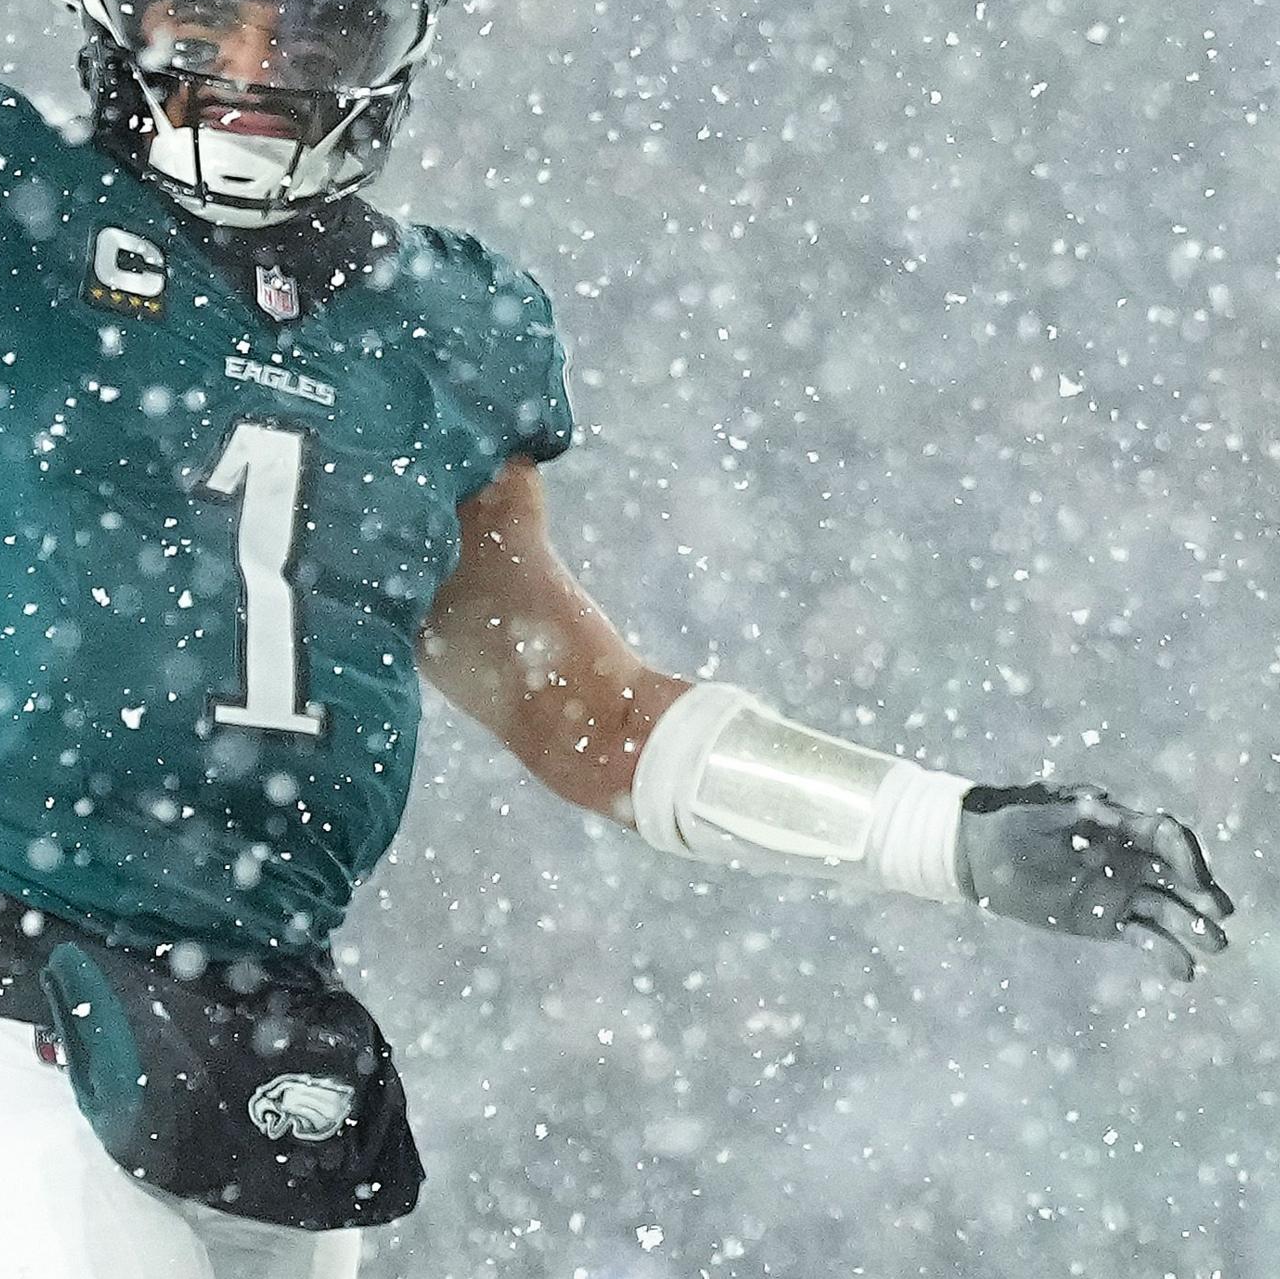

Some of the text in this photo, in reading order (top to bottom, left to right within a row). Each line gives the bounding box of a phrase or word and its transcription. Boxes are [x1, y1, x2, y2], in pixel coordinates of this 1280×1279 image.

[94, 227, 165, 297] C
[224, 355, 336, 407] EAGLES
[204, 422, 321, 736] 1
